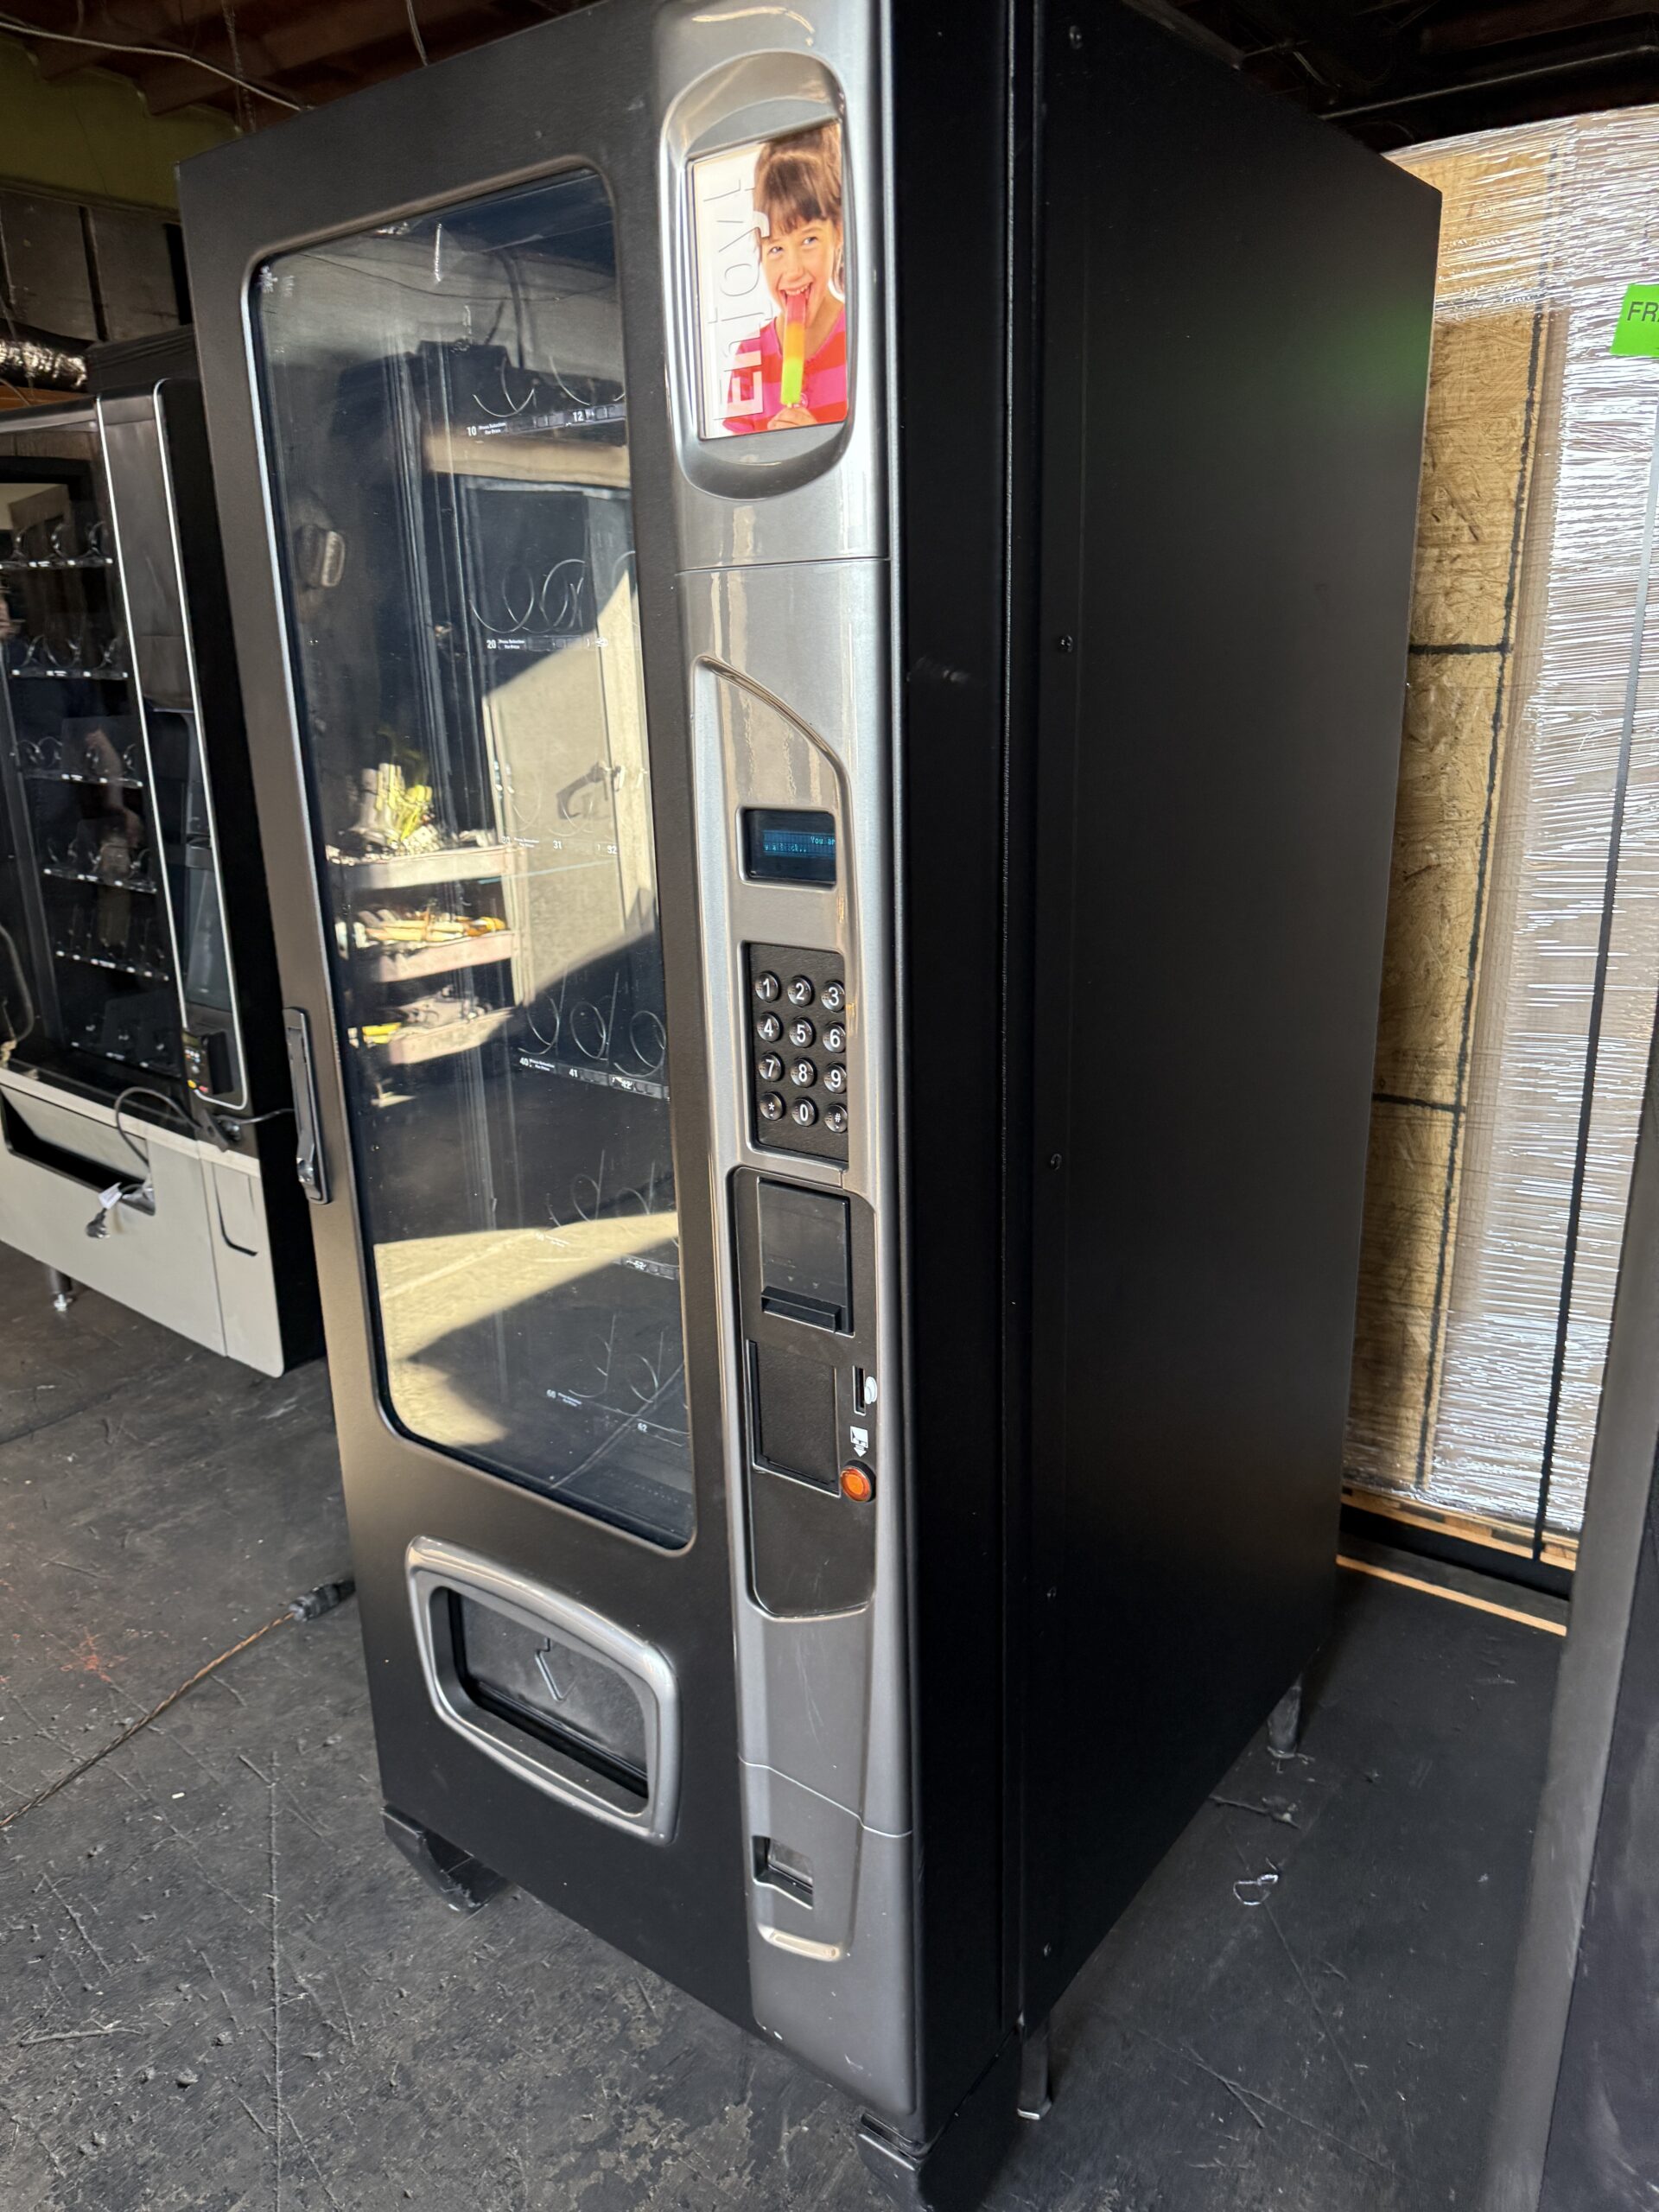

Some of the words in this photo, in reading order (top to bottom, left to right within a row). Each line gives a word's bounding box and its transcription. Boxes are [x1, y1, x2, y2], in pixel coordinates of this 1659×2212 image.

[1626, 301, 1659, 322] FR
[467, 425, 477, 436] 10
[486, 639, 497, 649] 20
[763, 978, 771, 997] 1
[795, 982, 805, 1001] 2
[828, 986, 840, 1007] 3
[763, 1018, 774, 1037] 4
[796, 1024, 806, 1043] 5
[830, 1028, 841, 1048] 6
[766, 1058, 775, 1077] 7
[798, 1063, 807, 1083] 8
[830, 1069, 842, 1089] 9
[799, 1103, 809, 1122] 0
